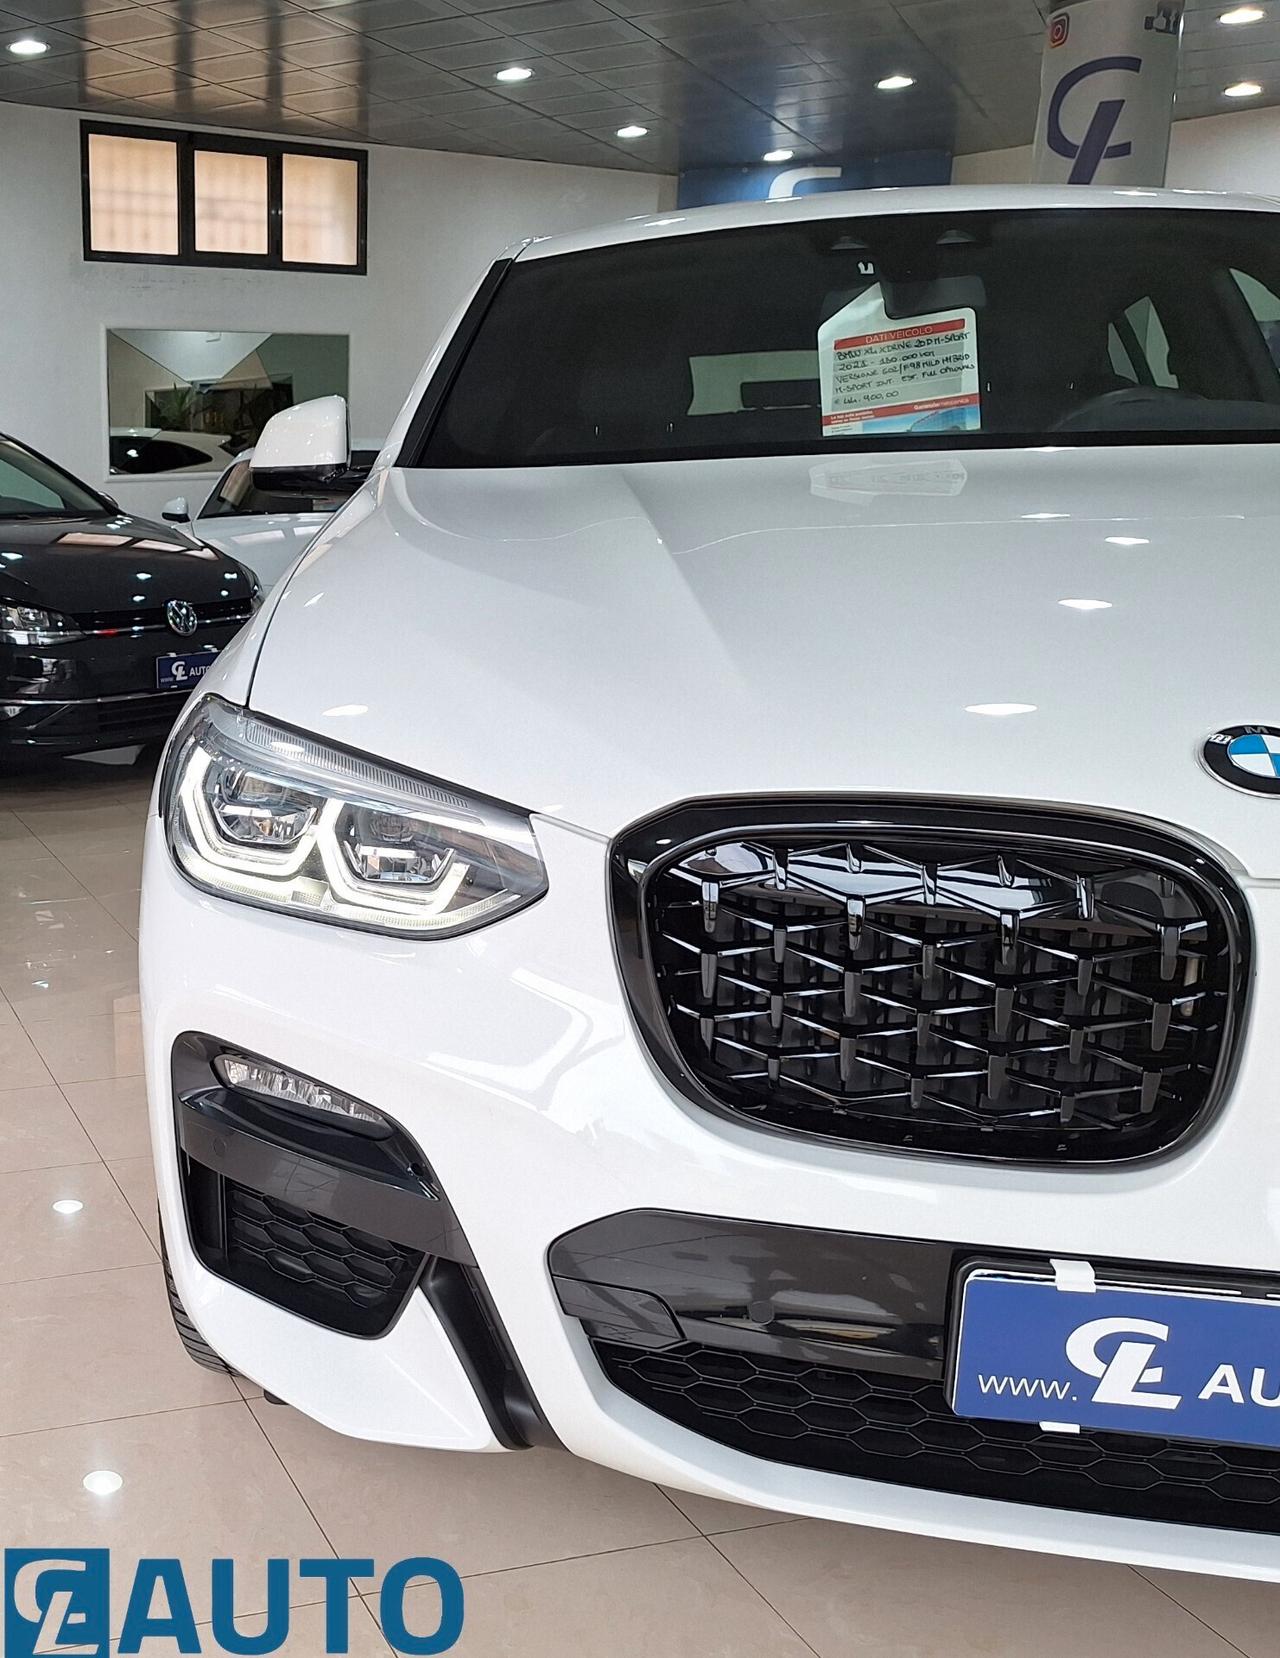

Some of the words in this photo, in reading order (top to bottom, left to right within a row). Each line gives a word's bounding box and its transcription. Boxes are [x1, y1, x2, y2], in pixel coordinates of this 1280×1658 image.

[865, 333, 887, 344] DATI
[888, 326, 933, 339] VEICOLO
[836, 350, 861, 361] BMW
[1197, 1364, 1280, 1408] AU
